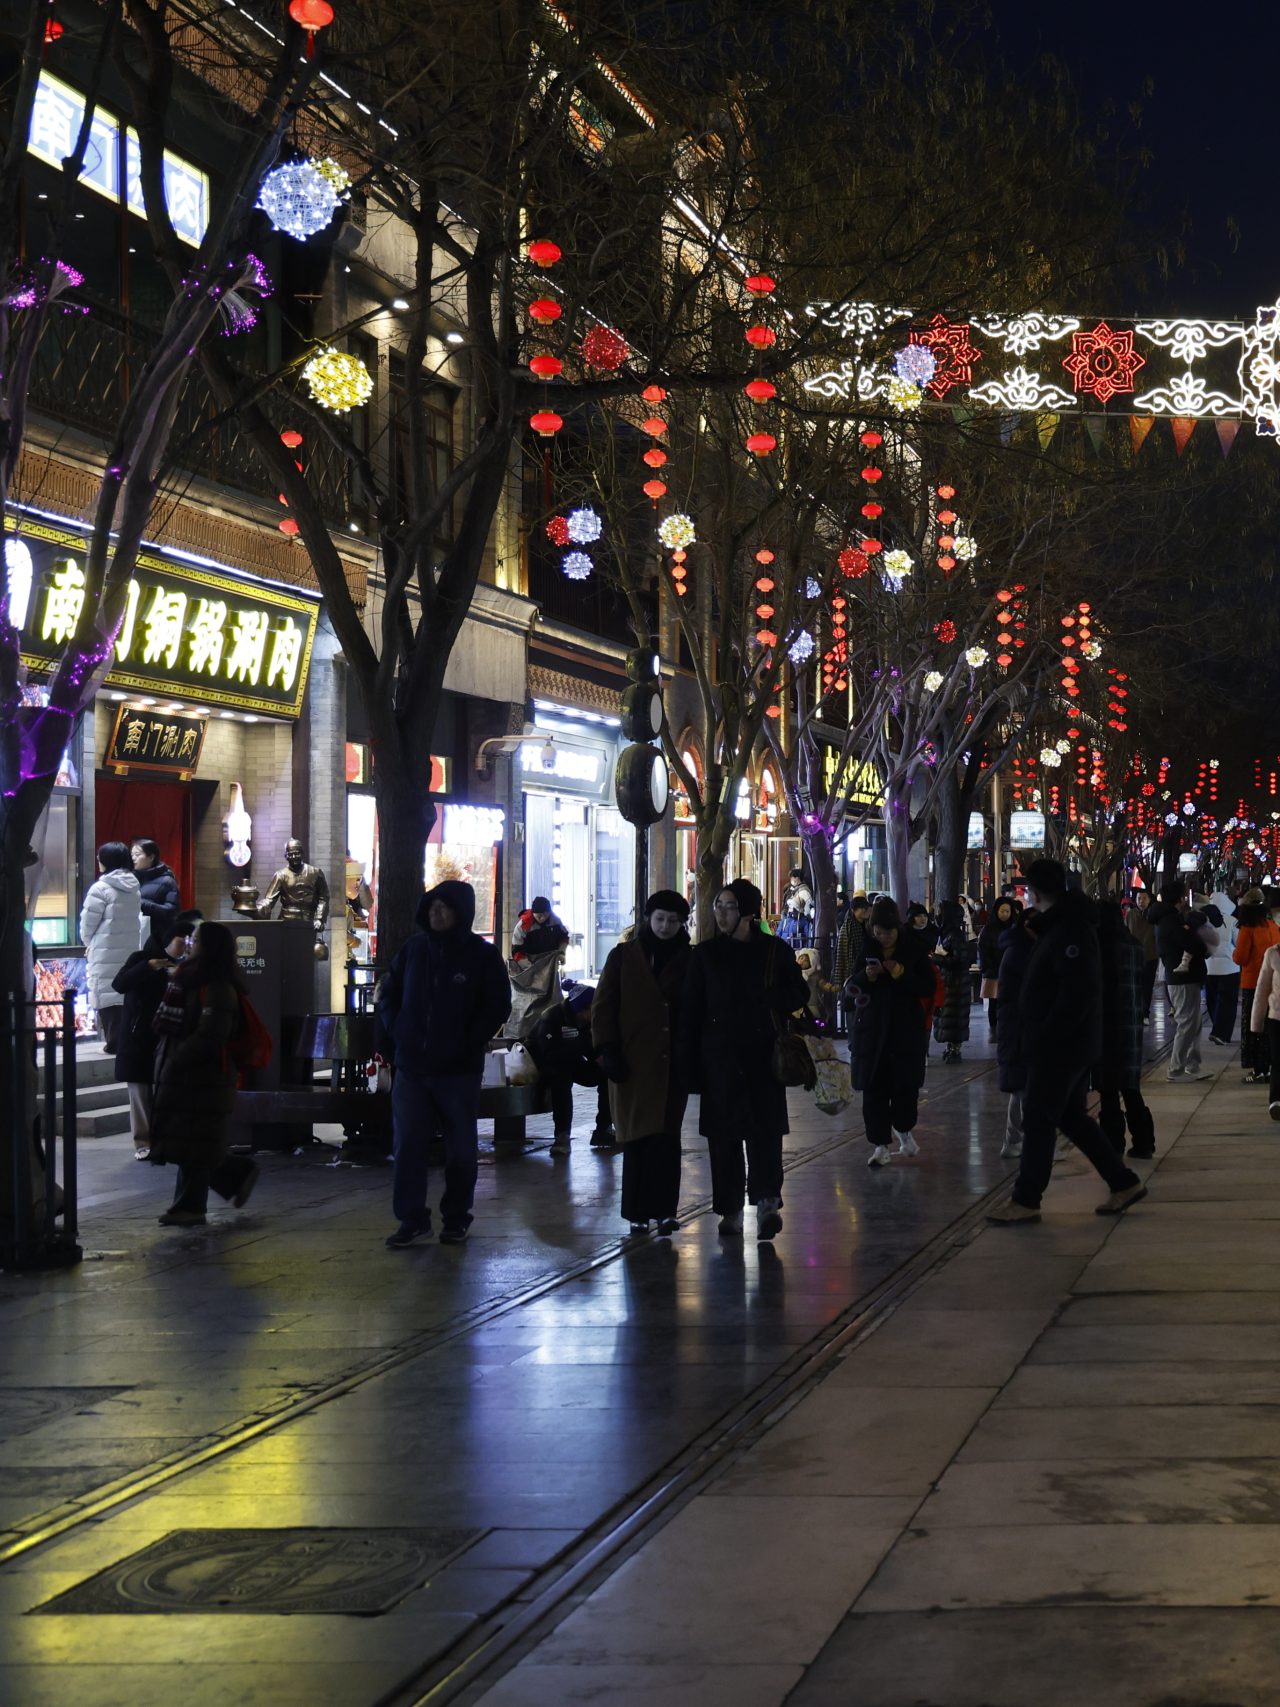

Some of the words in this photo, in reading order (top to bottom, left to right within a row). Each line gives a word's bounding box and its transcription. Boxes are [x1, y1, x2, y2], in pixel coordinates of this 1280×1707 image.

[33, 85, 201, 240] 南门肉
[123, 719, 198, 760] 南门涮肉
